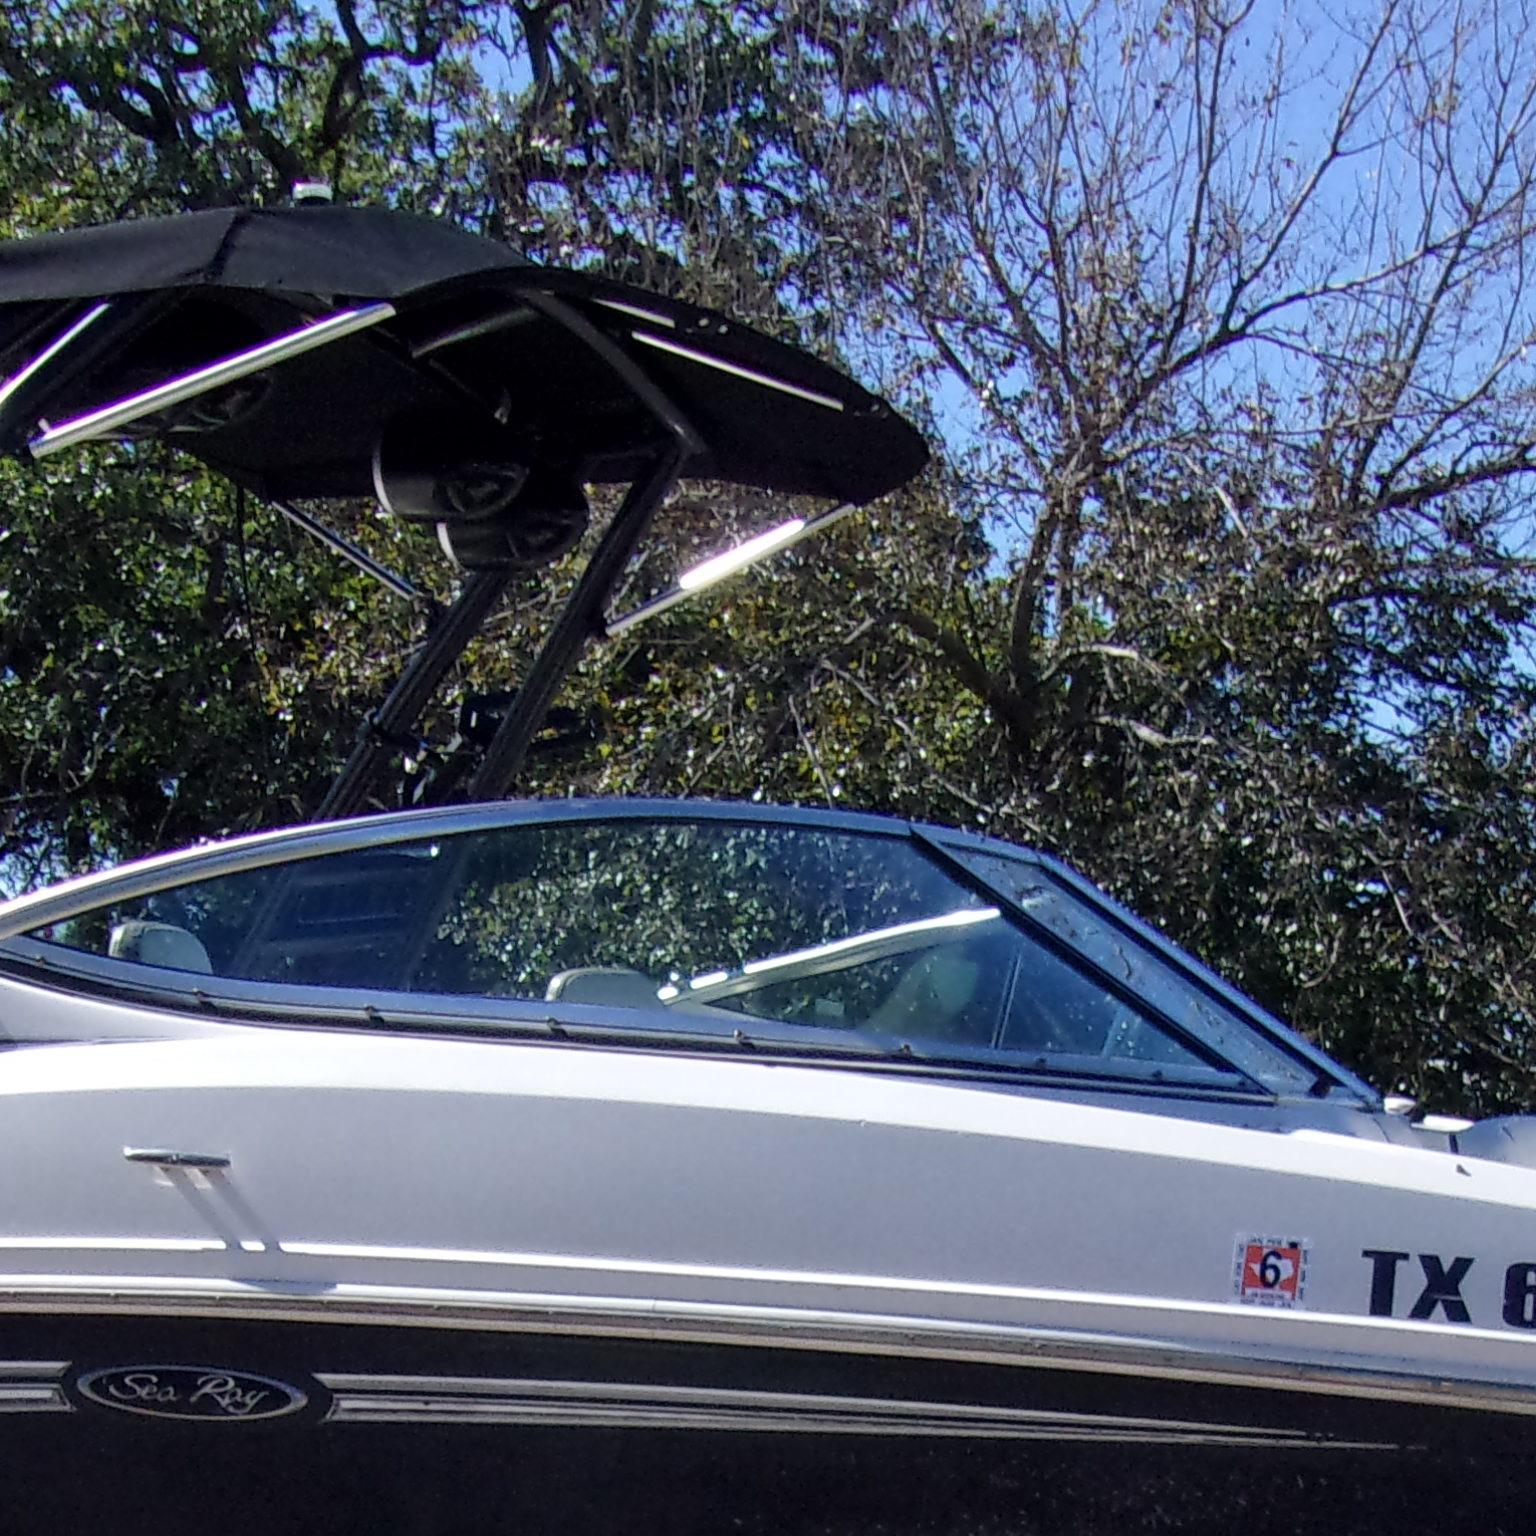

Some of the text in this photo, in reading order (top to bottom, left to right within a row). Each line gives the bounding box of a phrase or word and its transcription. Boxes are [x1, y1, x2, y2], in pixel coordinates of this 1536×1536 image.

[1260, 1249, 1282, 1289] 6
[1361, 1249, 1475, 1325] TX
[108, 1373, 271, 1416] Sea Ray
